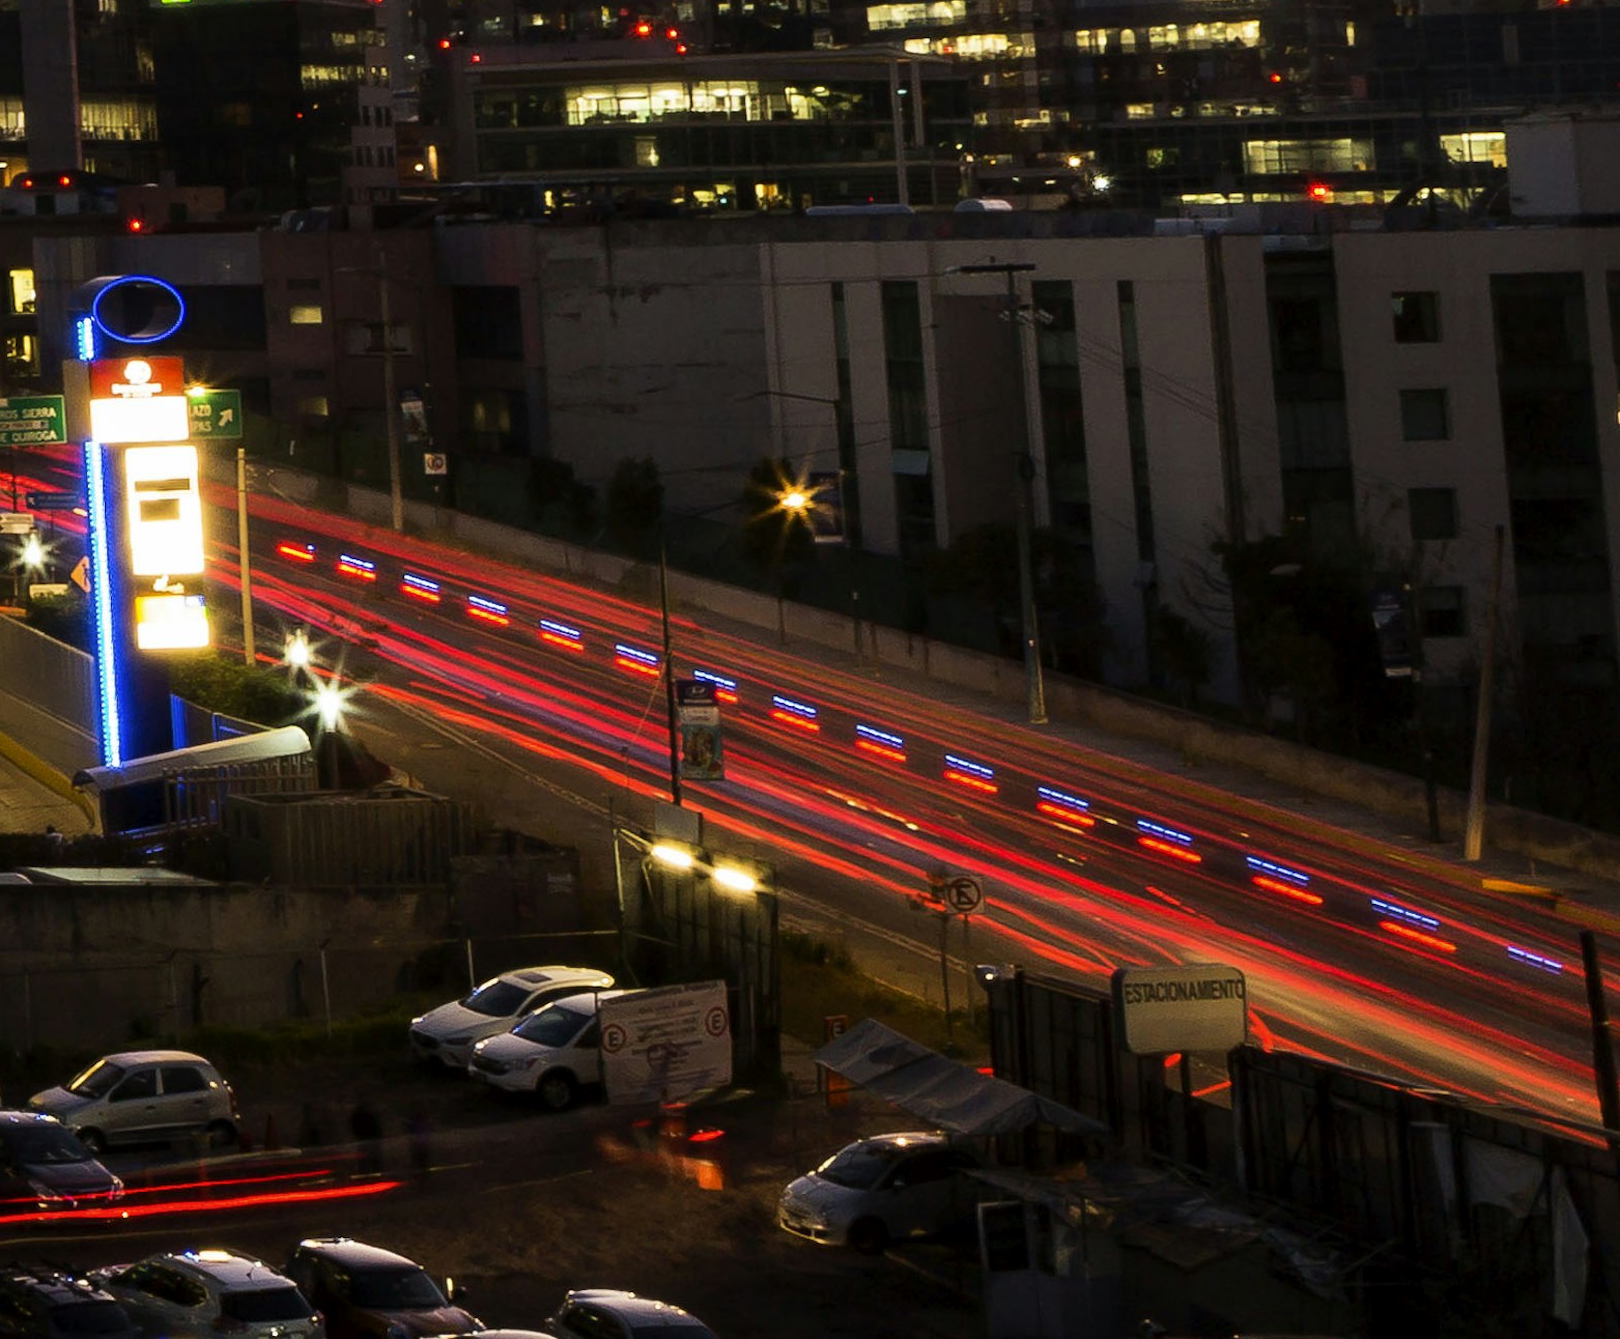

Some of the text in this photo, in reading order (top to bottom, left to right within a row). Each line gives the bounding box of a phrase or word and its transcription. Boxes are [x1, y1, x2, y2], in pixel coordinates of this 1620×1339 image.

[1124, 979, 1245, 1004] ESTACIONAMIENTO
[711, 1014, 722, 1030] E
[608, 1031, 619, 1044] E
